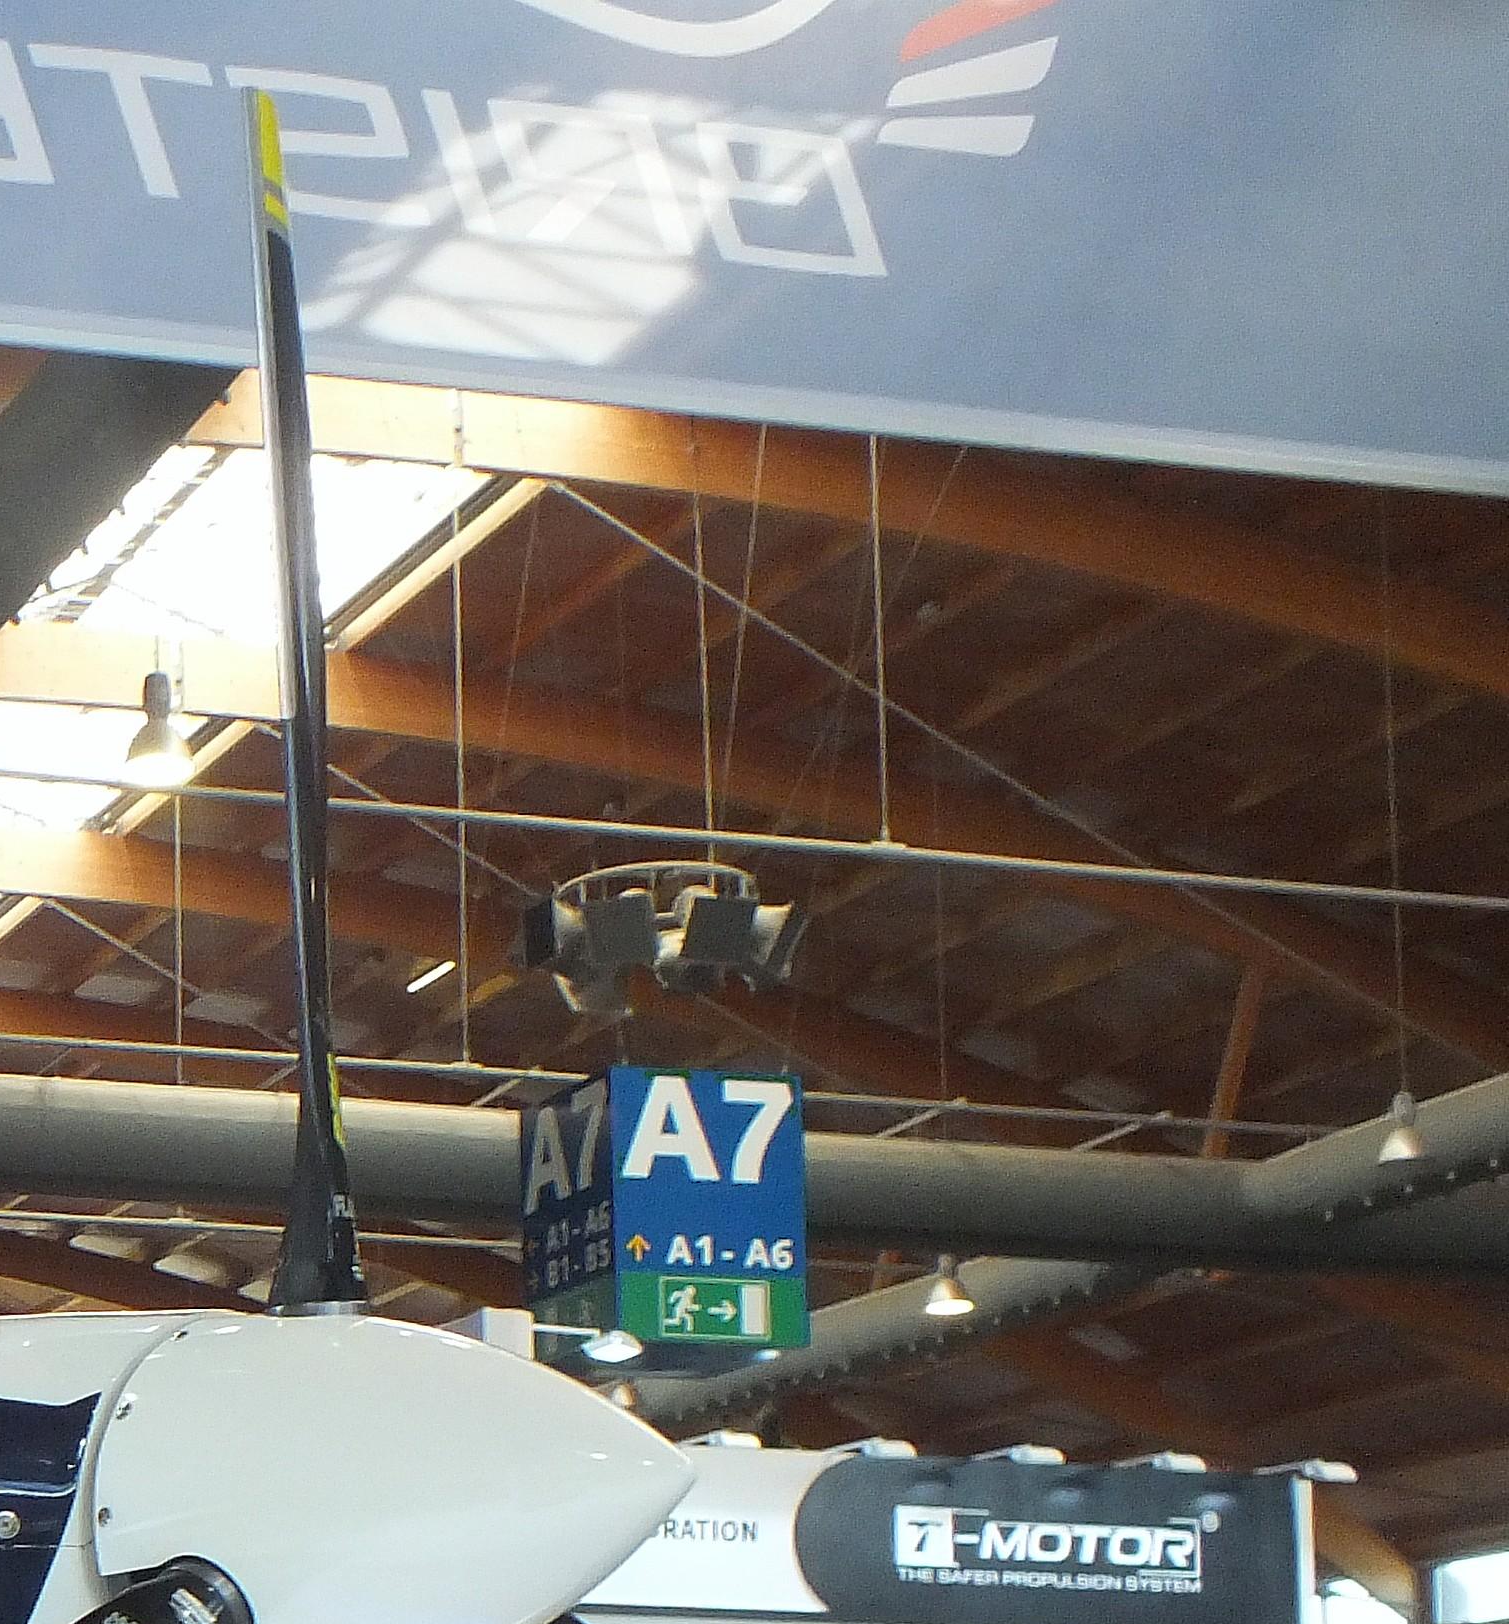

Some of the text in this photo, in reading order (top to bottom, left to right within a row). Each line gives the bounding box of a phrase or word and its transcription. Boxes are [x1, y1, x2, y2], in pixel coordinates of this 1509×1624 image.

[523, 1079, 607, 1216] A7
[622, 1075, 793, 1184] A7
[664, 1519, 758, 1541] RATION
[894, 1504, 1197, 1569] T-MOTOR
[897, 1567, 1202, 1594] THE SAFER PROPULSION SYSTEM
